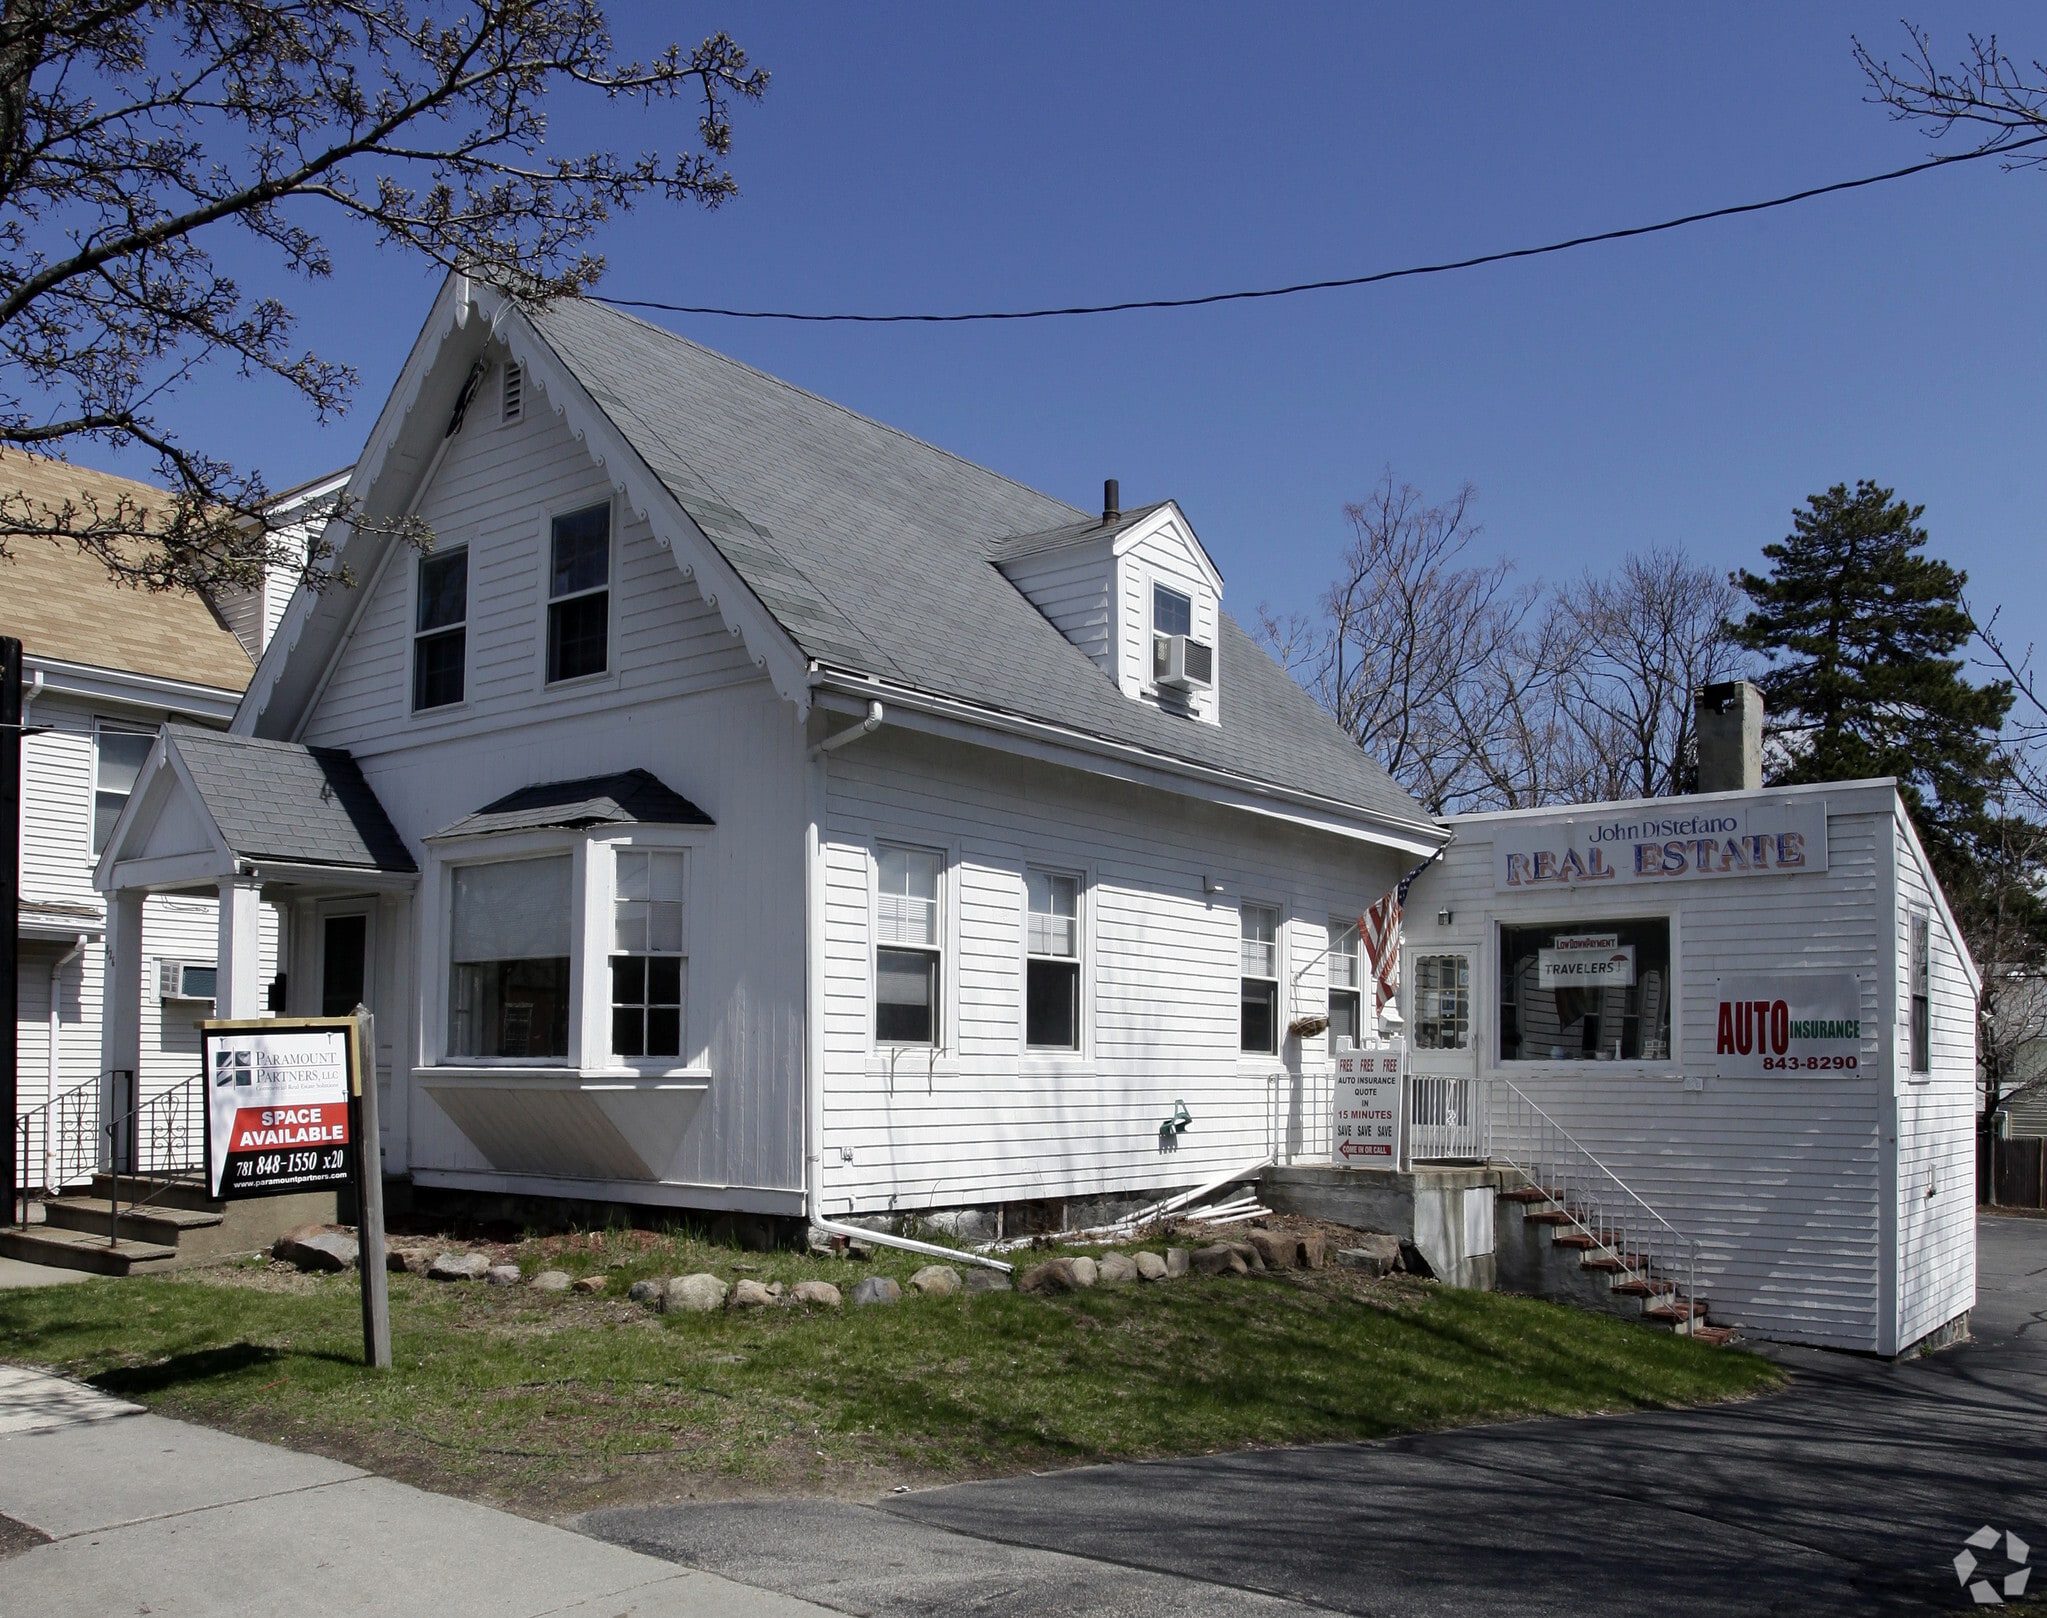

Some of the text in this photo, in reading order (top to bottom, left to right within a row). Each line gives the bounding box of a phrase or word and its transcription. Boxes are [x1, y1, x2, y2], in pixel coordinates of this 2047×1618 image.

[1589, 816, 1738, 843] John DiStefano
[1506, 832, 1806, 886] REAL ESTATE
[1545, 962, 1614, 975] TRAVELERS
[1717, 999, 1861, 1056] AUTO INSURANCE
[256, 1051, 337, 1066] PARAMOUNT
[1339, 1058, 1398, 1073] FREE FREE FREE
[1762, 1055, 1858, 1070] 843-8290
[322, 1071, 339, 1080] LLC
[1338, 1076, 1396, 1085] AUTO INSURANCE
[1354, 1088, 1377, 1096] QUOTE
[1361, 1099, 1369, 1107] IN
[261, 1108, 322, 1126] SPACE
[1338, 1110, 1392, 1120] 15 MINUTES
[239, 1125, 344, 1147] AVAILABLE
[1337, 1125, 1392, 1137] SAVE SAVE SAVE
[1342, 1145, 1358, 1154] COME
[1364, 1145, 1373, 1154] OR
[1373, 1145, 1387, 1154] CALL
[236, 1149, 344, 1177] 781 848-1550 x20
[233, 1171, 347, 1188] www.paramountpartners.com
